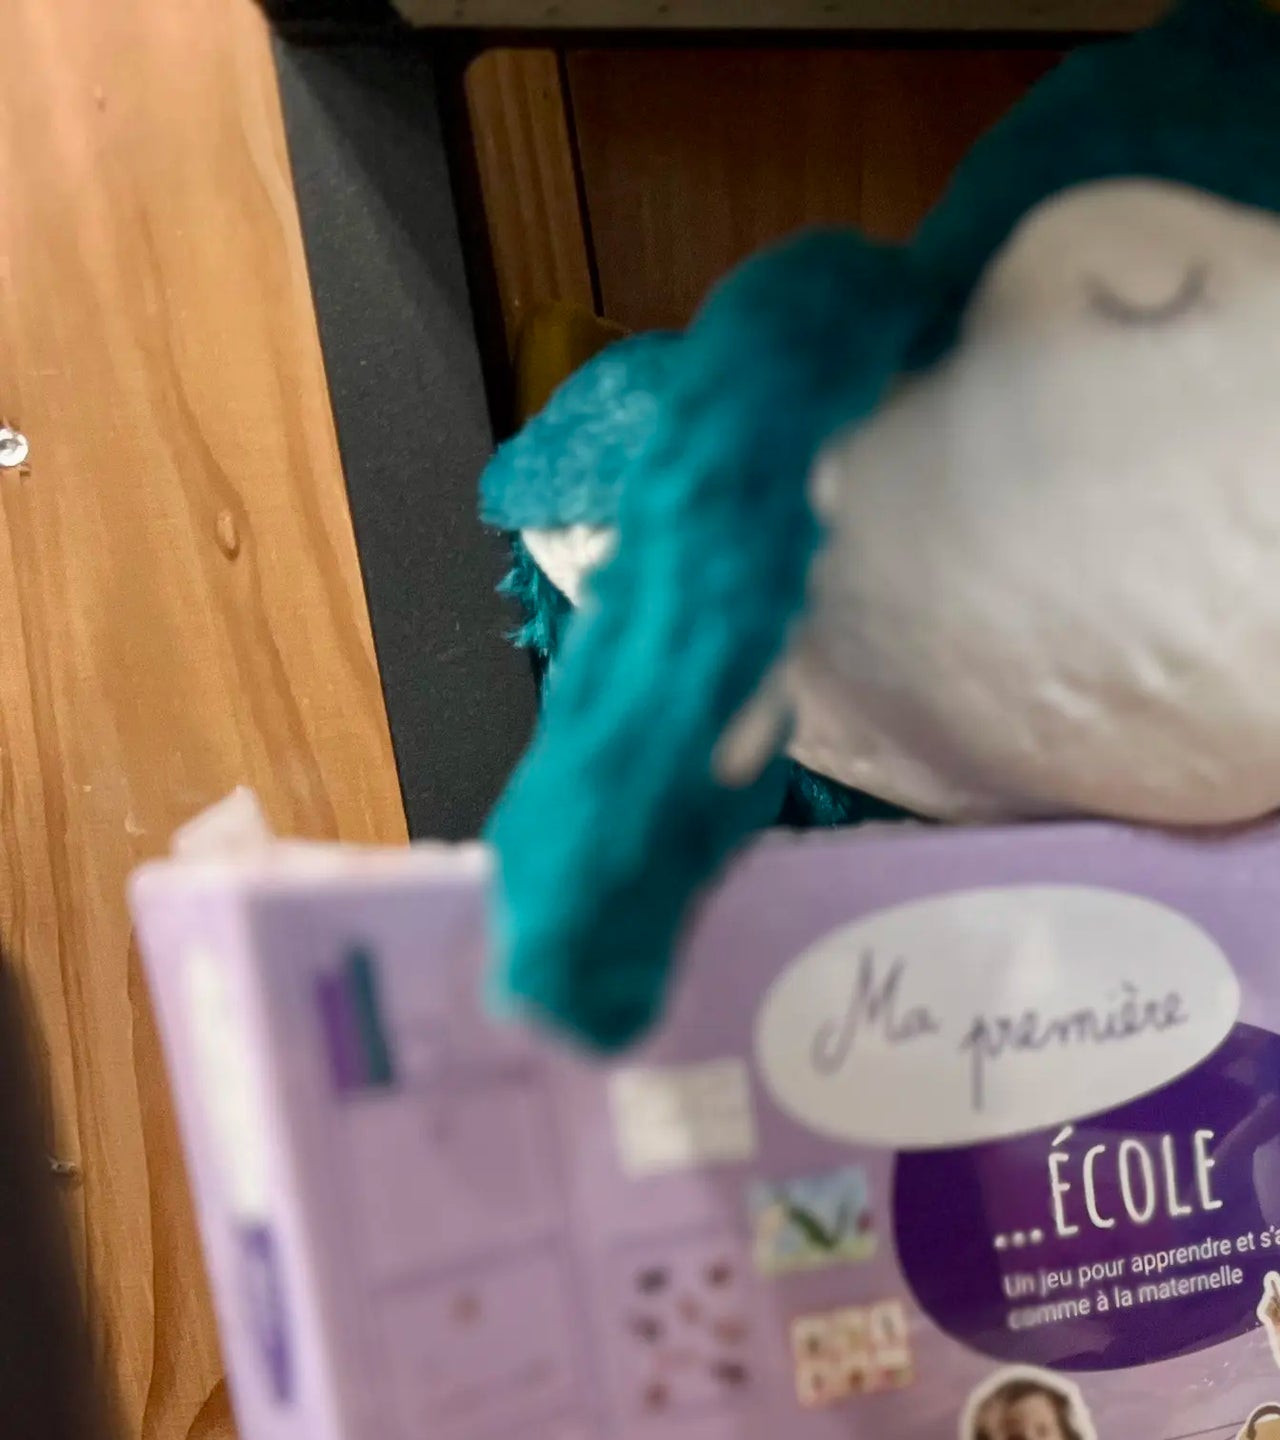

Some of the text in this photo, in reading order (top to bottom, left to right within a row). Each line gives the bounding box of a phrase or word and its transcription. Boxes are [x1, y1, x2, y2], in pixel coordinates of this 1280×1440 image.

[809, 947, 1189, 1111] Ma première
[1004, 1272, 1034, 1298] Un
[1037, 1265, 1073, 1294] jeu
[1077, 1258, 1125, 1289] pour
[1131, 1240, 1233, 1282] apprendre
[1235, 1233, 1256, 1257] et
[1008, 1265, 1244, 1331] comme à la maternelle
